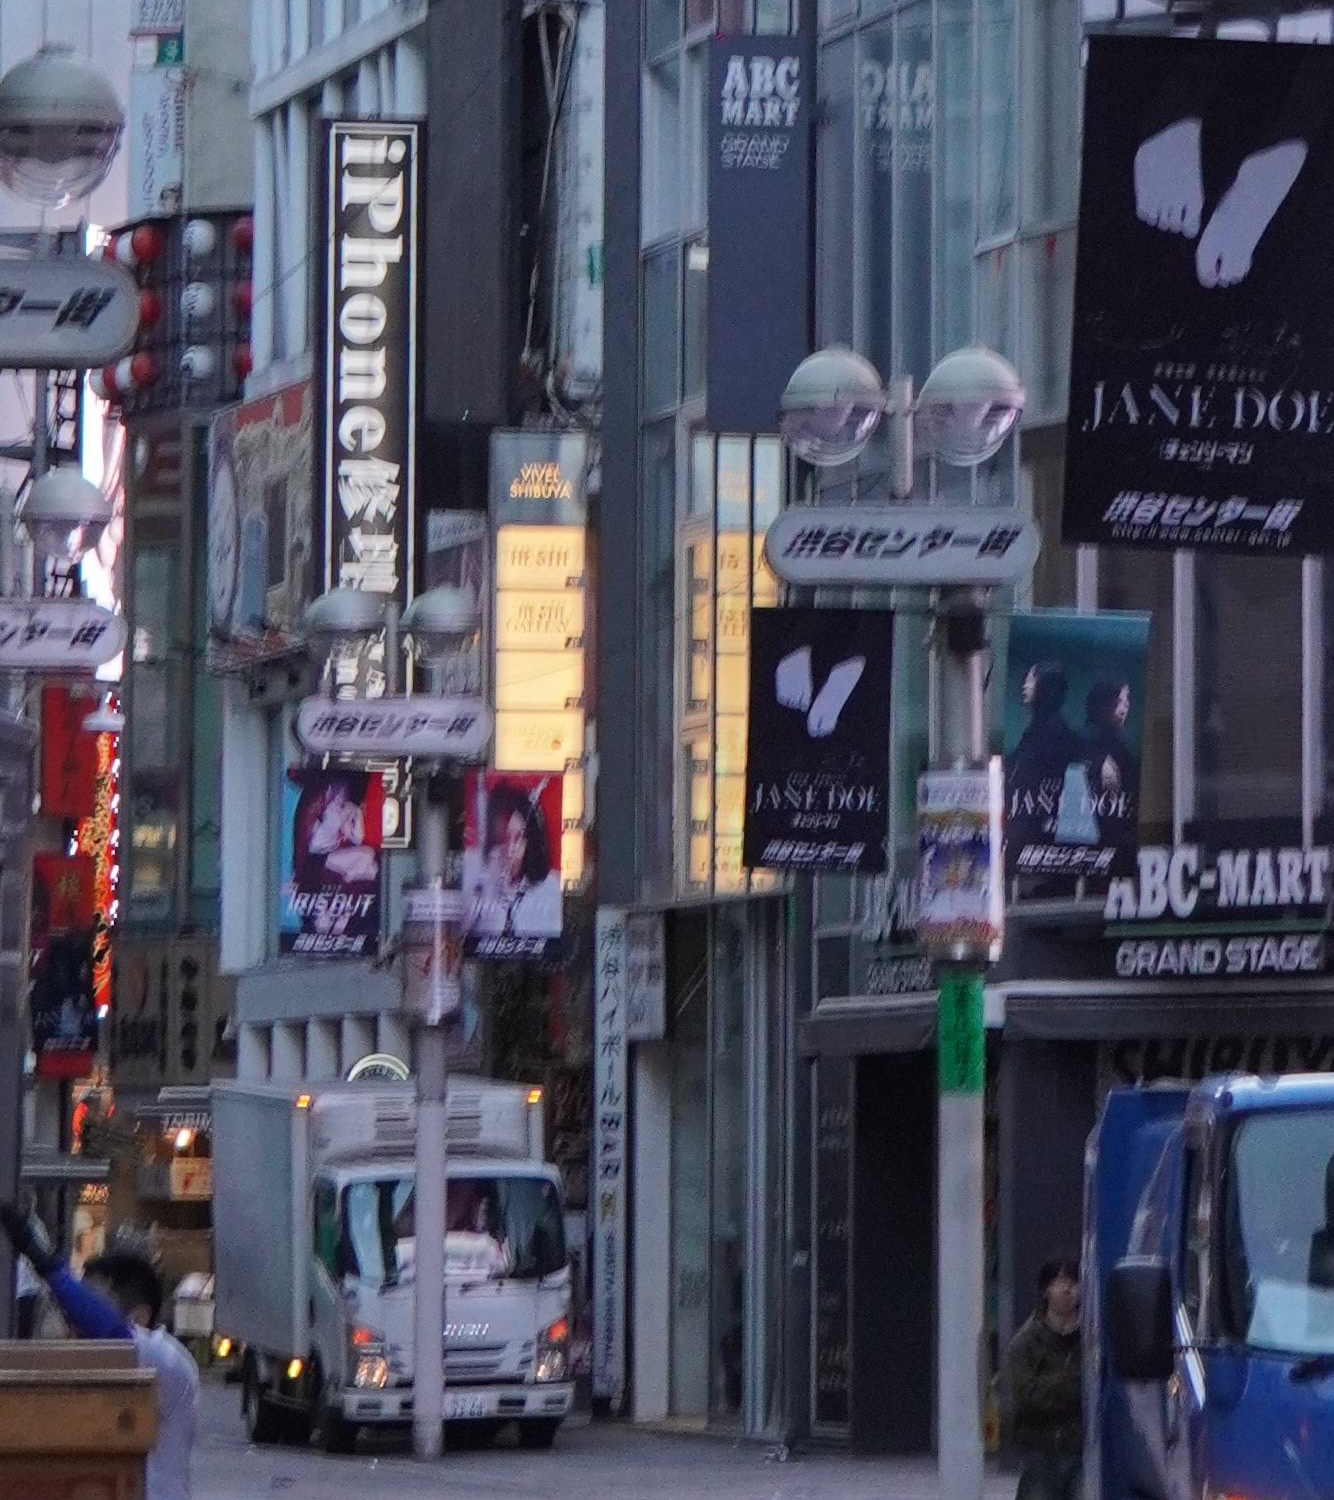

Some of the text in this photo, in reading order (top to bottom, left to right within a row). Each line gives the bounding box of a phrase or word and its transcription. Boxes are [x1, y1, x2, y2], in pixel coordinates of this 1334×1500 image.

[721, 54, 801, 101] ABC
[721, 97, 801, 127] MART
[1082, 380, 1334, 435] JANE DOE
[1102, 489, 1305, 532] 渋谷センター街
[783, 522, 1025, 560] 渋谷センター街
[310, 711, 479, 739] 渋谷センター街
[1115, 937, 1324, 976] GRAND STAGE
